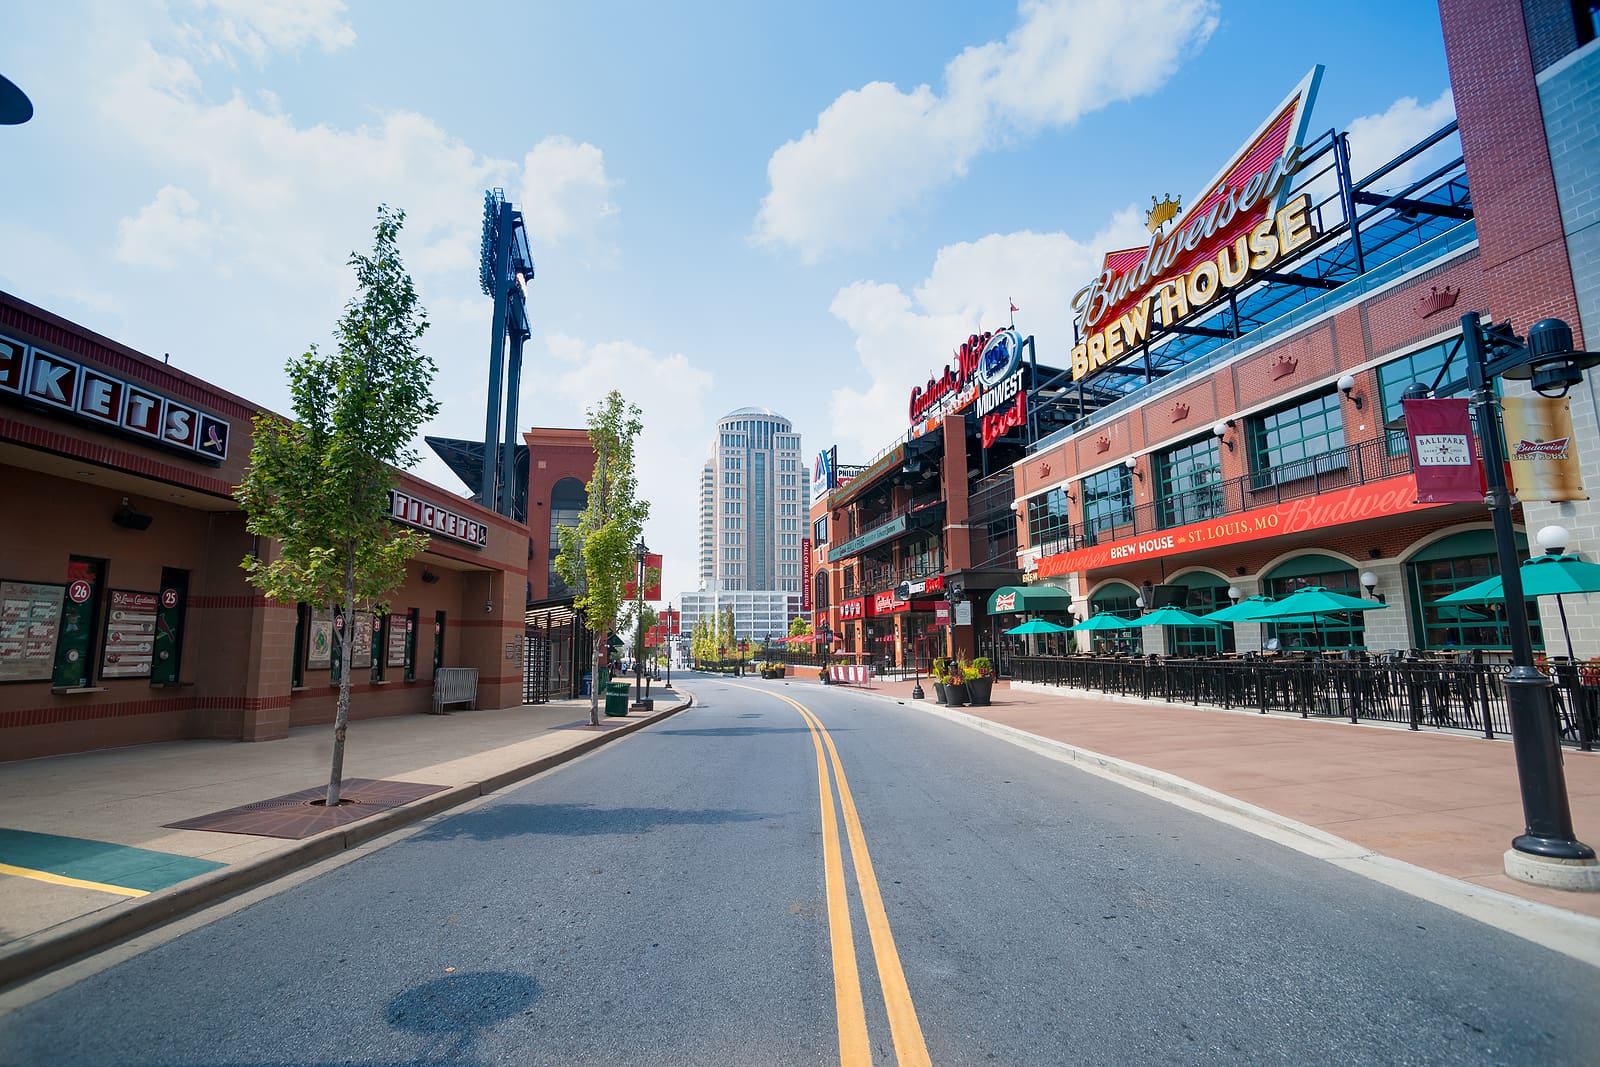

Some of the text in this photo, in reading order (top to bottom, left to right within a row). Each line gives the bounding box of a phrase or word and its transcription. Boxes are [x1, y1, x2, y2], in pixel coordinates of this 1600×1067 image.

[1070, 144, 1303, 333] Budweiser
[1071, 193, 1317, 382] BREW HOUSE
[976, 368, 1024, 419] MIDWEST
[1419, 437, 1465, 446] BALLPARK
[1513, 442, 1569, 453] Budweiser
[838, 469, 863, 477] PHILLIP
[396, 495, 478, 541] TICKETS
[1037, 548, 1109, 577] Budweiser
[1110, 543, 1137, 559] BREW
[1139, 536, 1175, 554] HOUSE
[1188, 530, 1206, 543] ST.
[1208, 520, 1253, 539] LOUIS,
[1254, 514, 1279, 531] MO
[803, 555, 809, 563] OF
[74, 585, 87, 599] 26
[165, 592, 176, 604] 25
